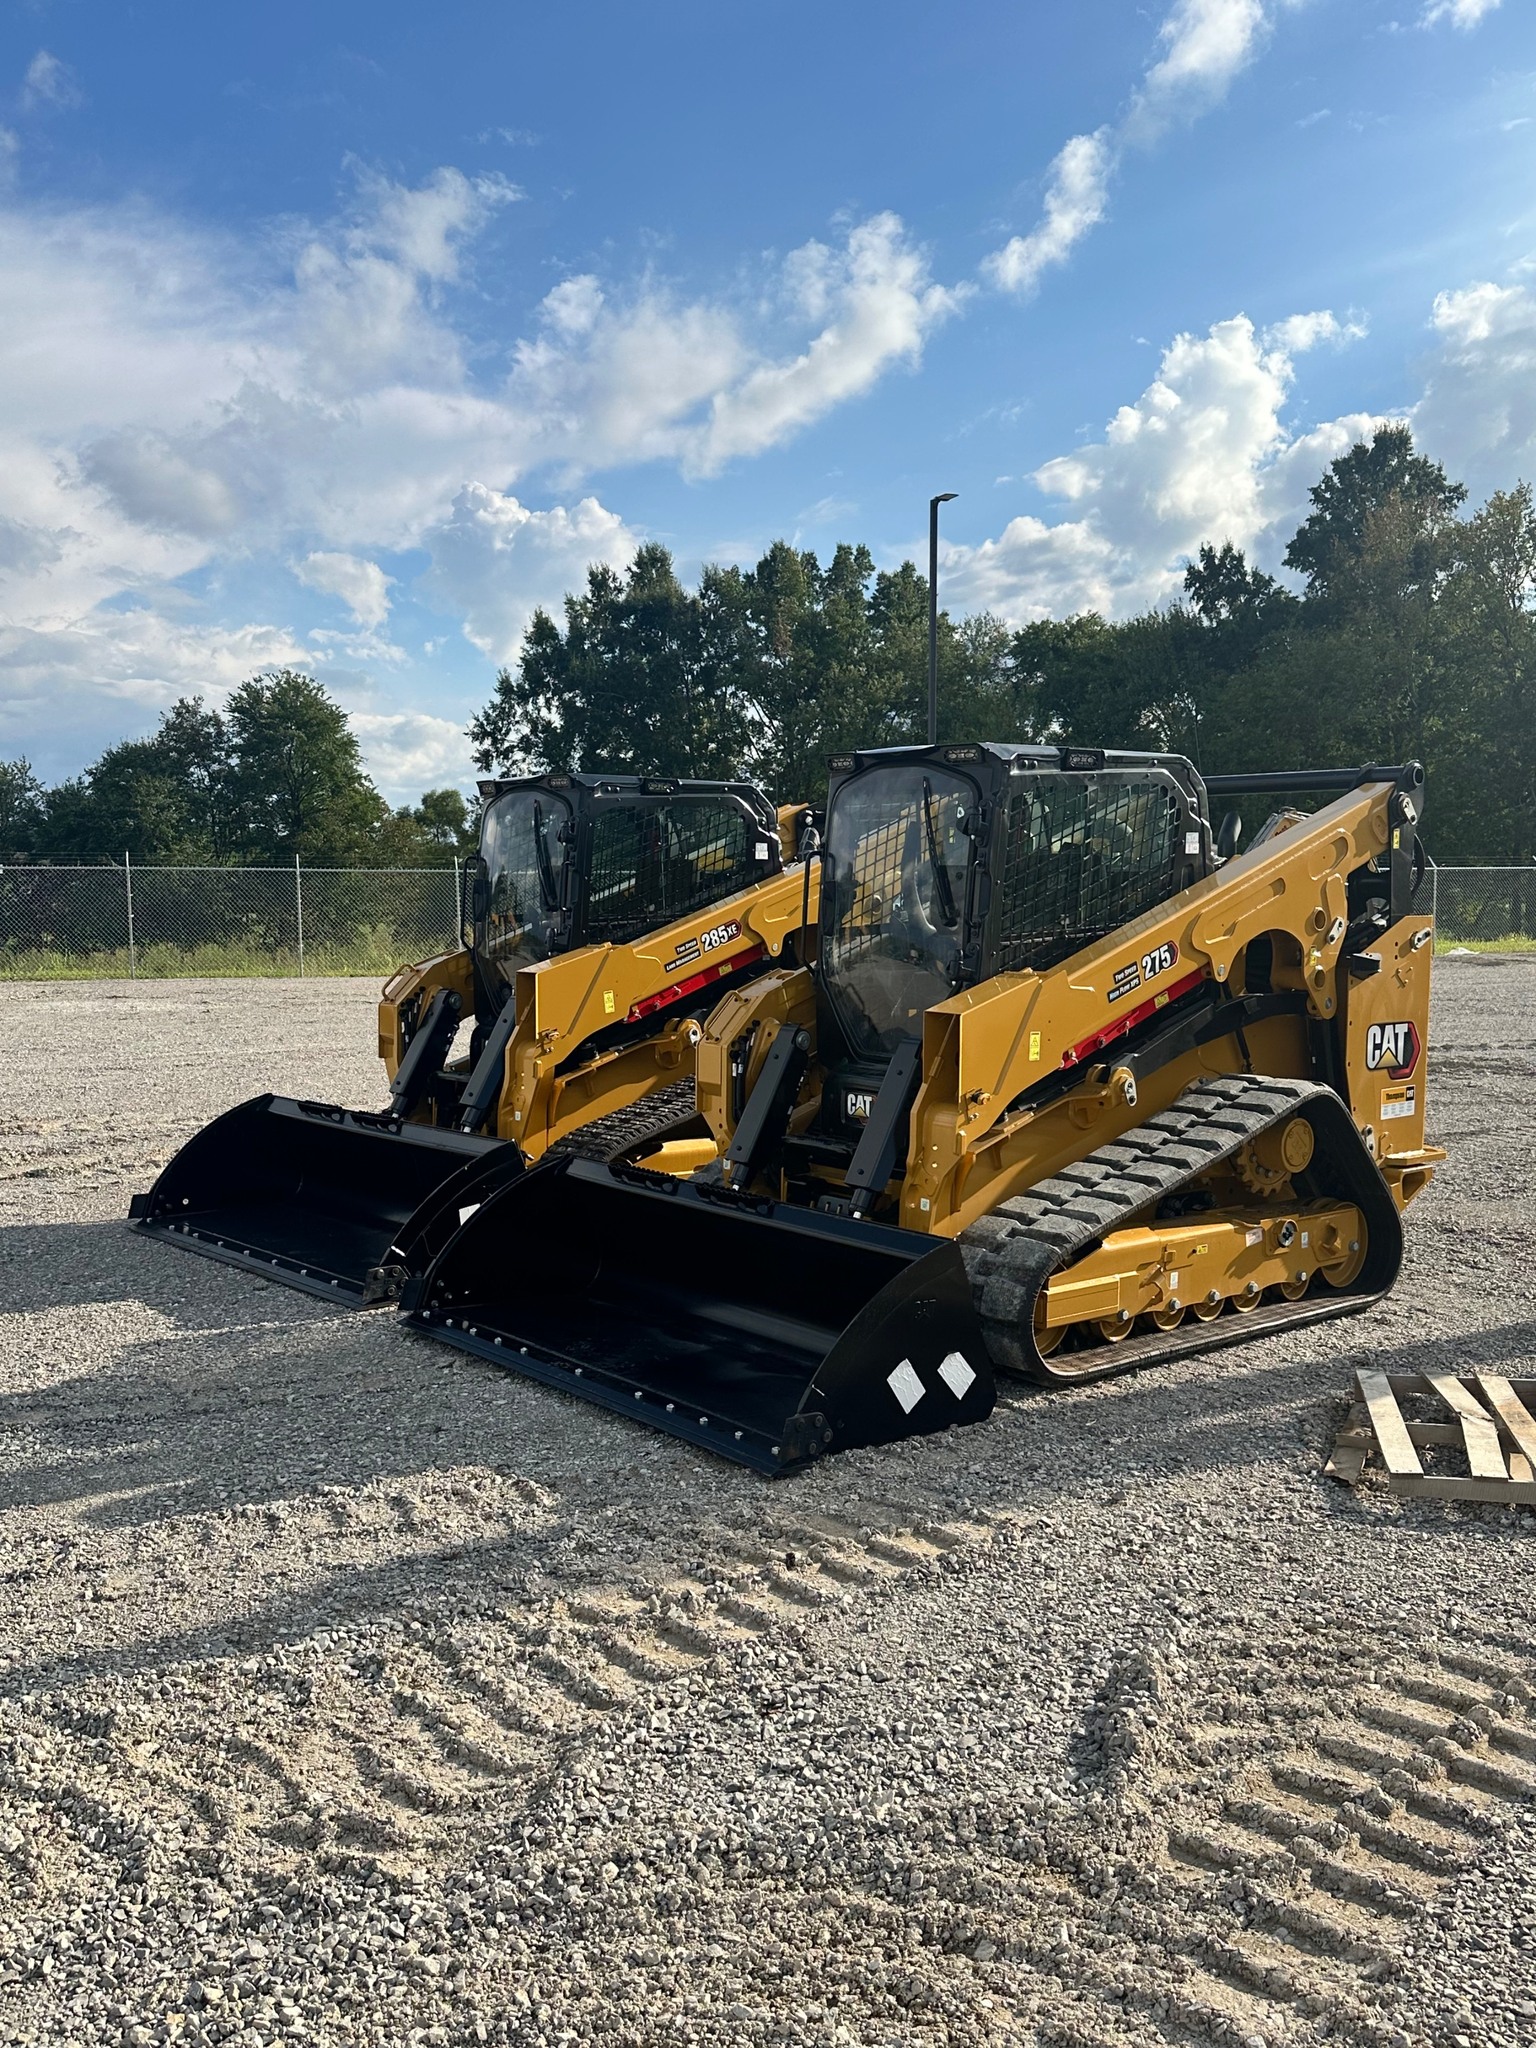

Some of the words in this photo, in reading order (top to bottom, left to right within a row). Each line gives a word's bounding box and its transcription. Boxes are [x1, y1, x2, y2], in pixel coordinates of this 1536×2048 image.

[701, 923, 738, 952] 285XE
[1142, 944, 1171, 980] 275
[1367, 1023, 1408, 1069] CAT
[848, 1093, 872, 1117] CAT
